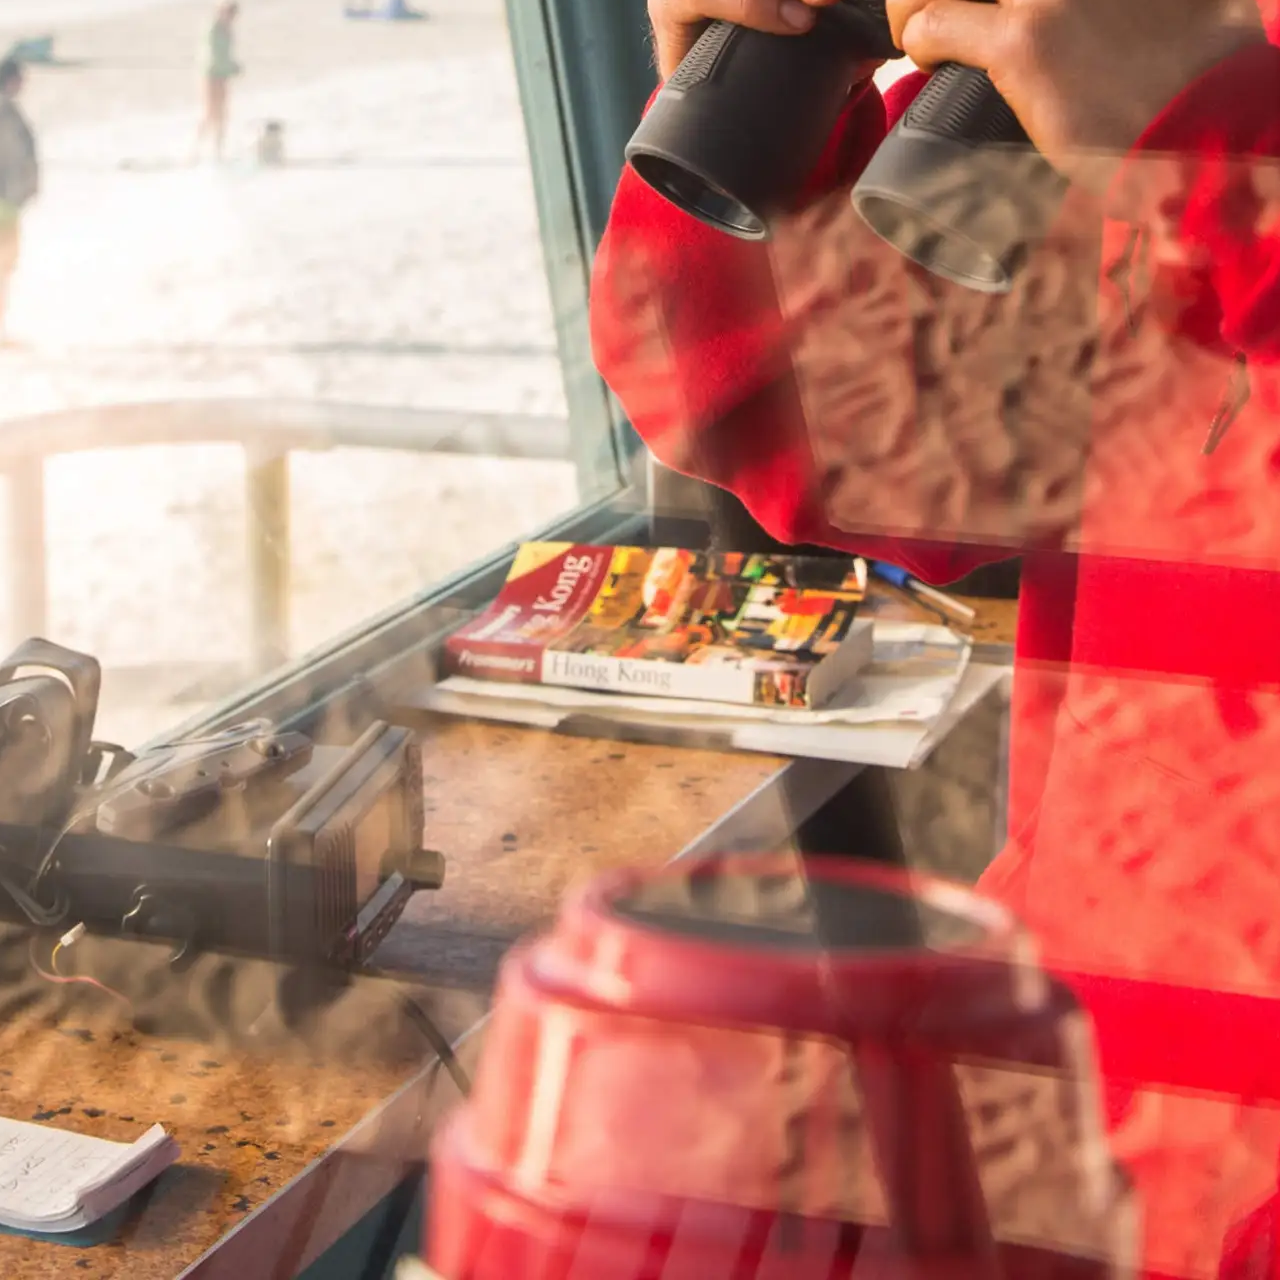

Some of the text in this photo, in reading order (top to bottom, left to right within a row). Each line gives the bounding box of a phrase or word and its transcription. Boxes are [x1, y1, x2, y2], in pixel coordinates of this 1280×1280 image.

[531, 552, 593, 613] Kong
[551, 653, 672, 690] Hong Kong
